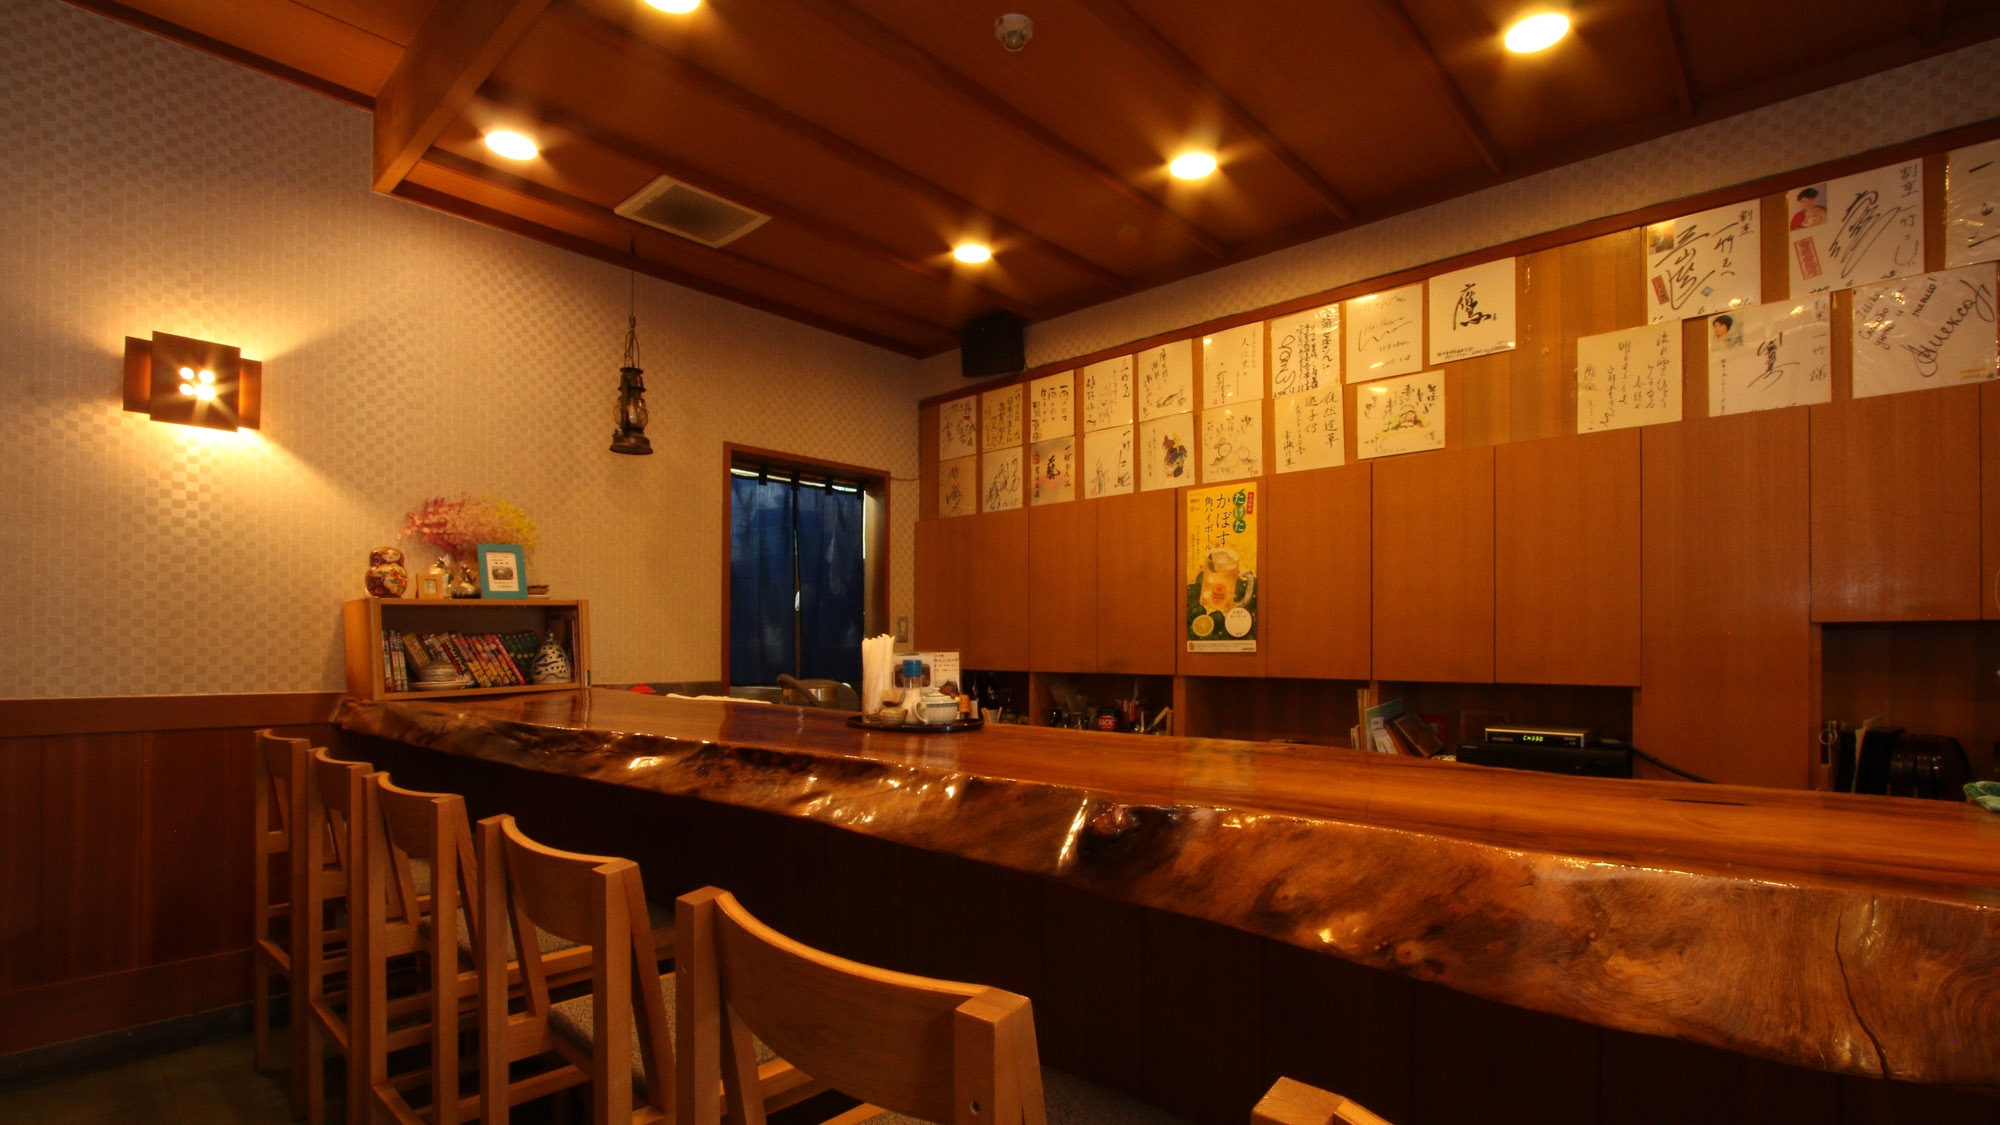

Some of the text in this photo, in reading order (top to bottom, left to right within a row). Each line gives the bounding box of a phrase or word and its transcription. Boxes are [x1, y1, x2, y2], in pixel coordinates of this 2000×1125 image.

[1204, 496, 1214, 551] 角ハイボール
[1215, 493, 1232, 548] かぼす
[1233, 492, 1246, 533] たけた
